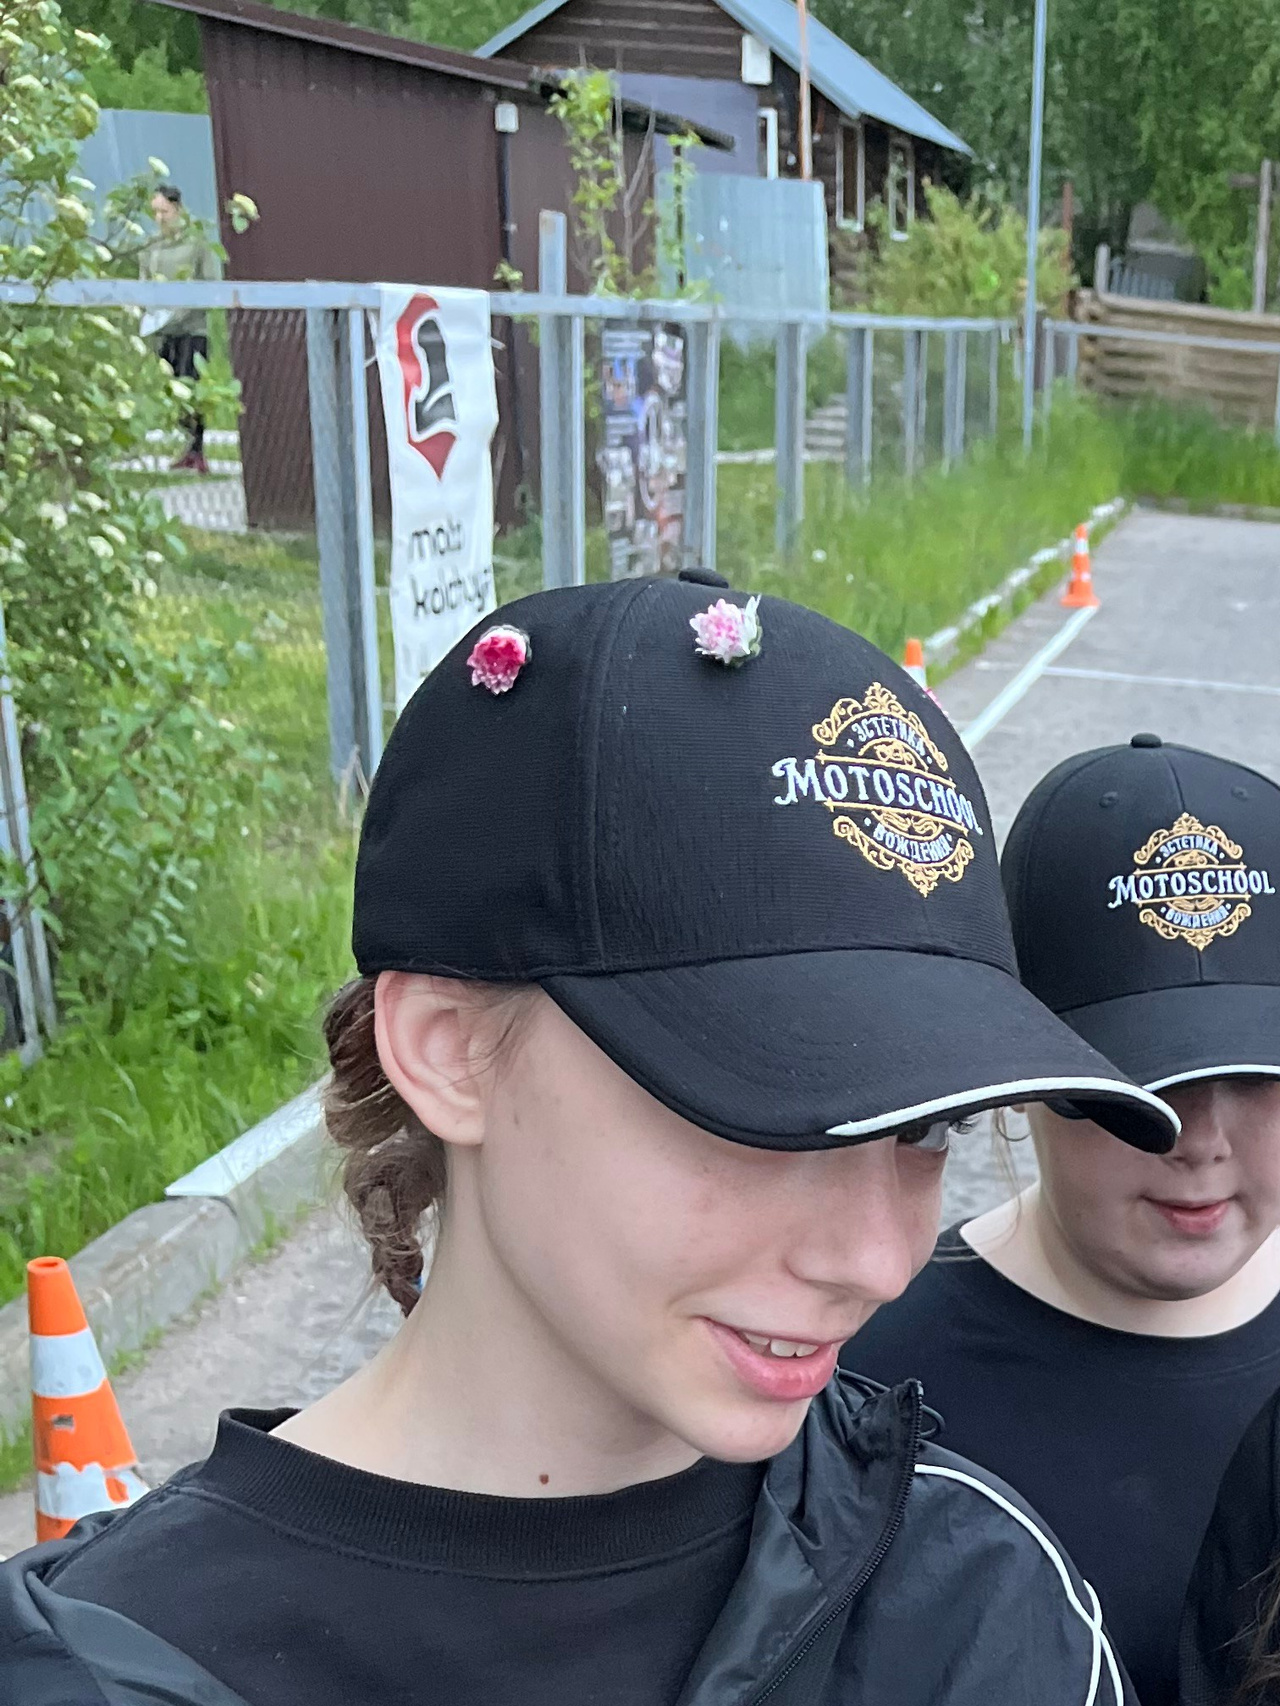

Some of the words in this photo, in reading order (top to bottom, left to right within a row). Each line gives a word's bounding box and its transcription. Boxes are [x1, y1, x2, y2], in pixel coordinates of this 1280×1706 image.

[851, 715, 926, 756] ЭСТЕТИКА
[771, 757, 984, 836] MOTOSCHOOL
[1159, 835, 1219, 858] ЭСТЕТИКА
[1107, 869, 1276, 909] MOTOSCHOOL
